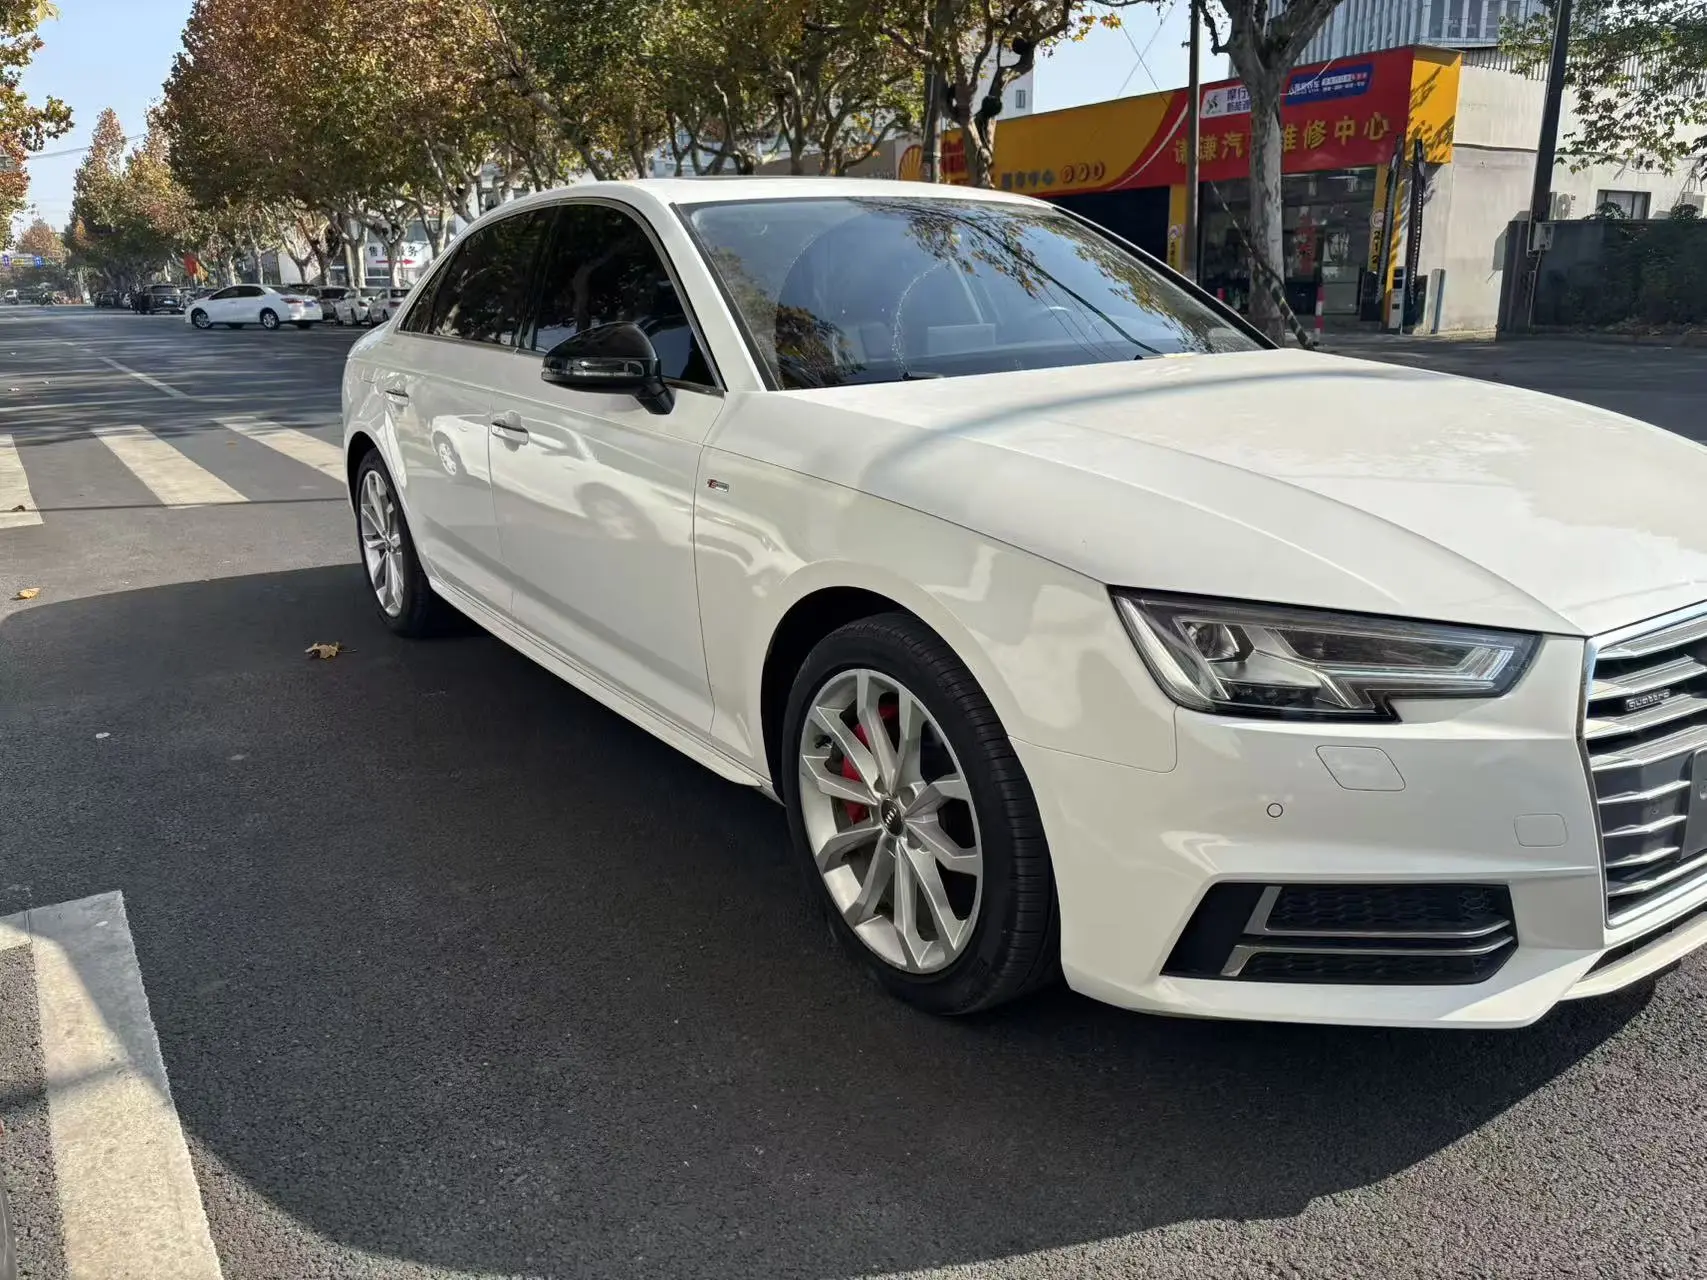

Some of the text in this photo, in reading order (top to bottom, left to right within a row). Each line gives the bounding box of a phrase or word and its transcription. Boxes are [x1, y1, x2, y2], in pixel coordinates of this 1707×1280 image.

[1174, 111, 1389, 165] 谦谦汽维修中心
